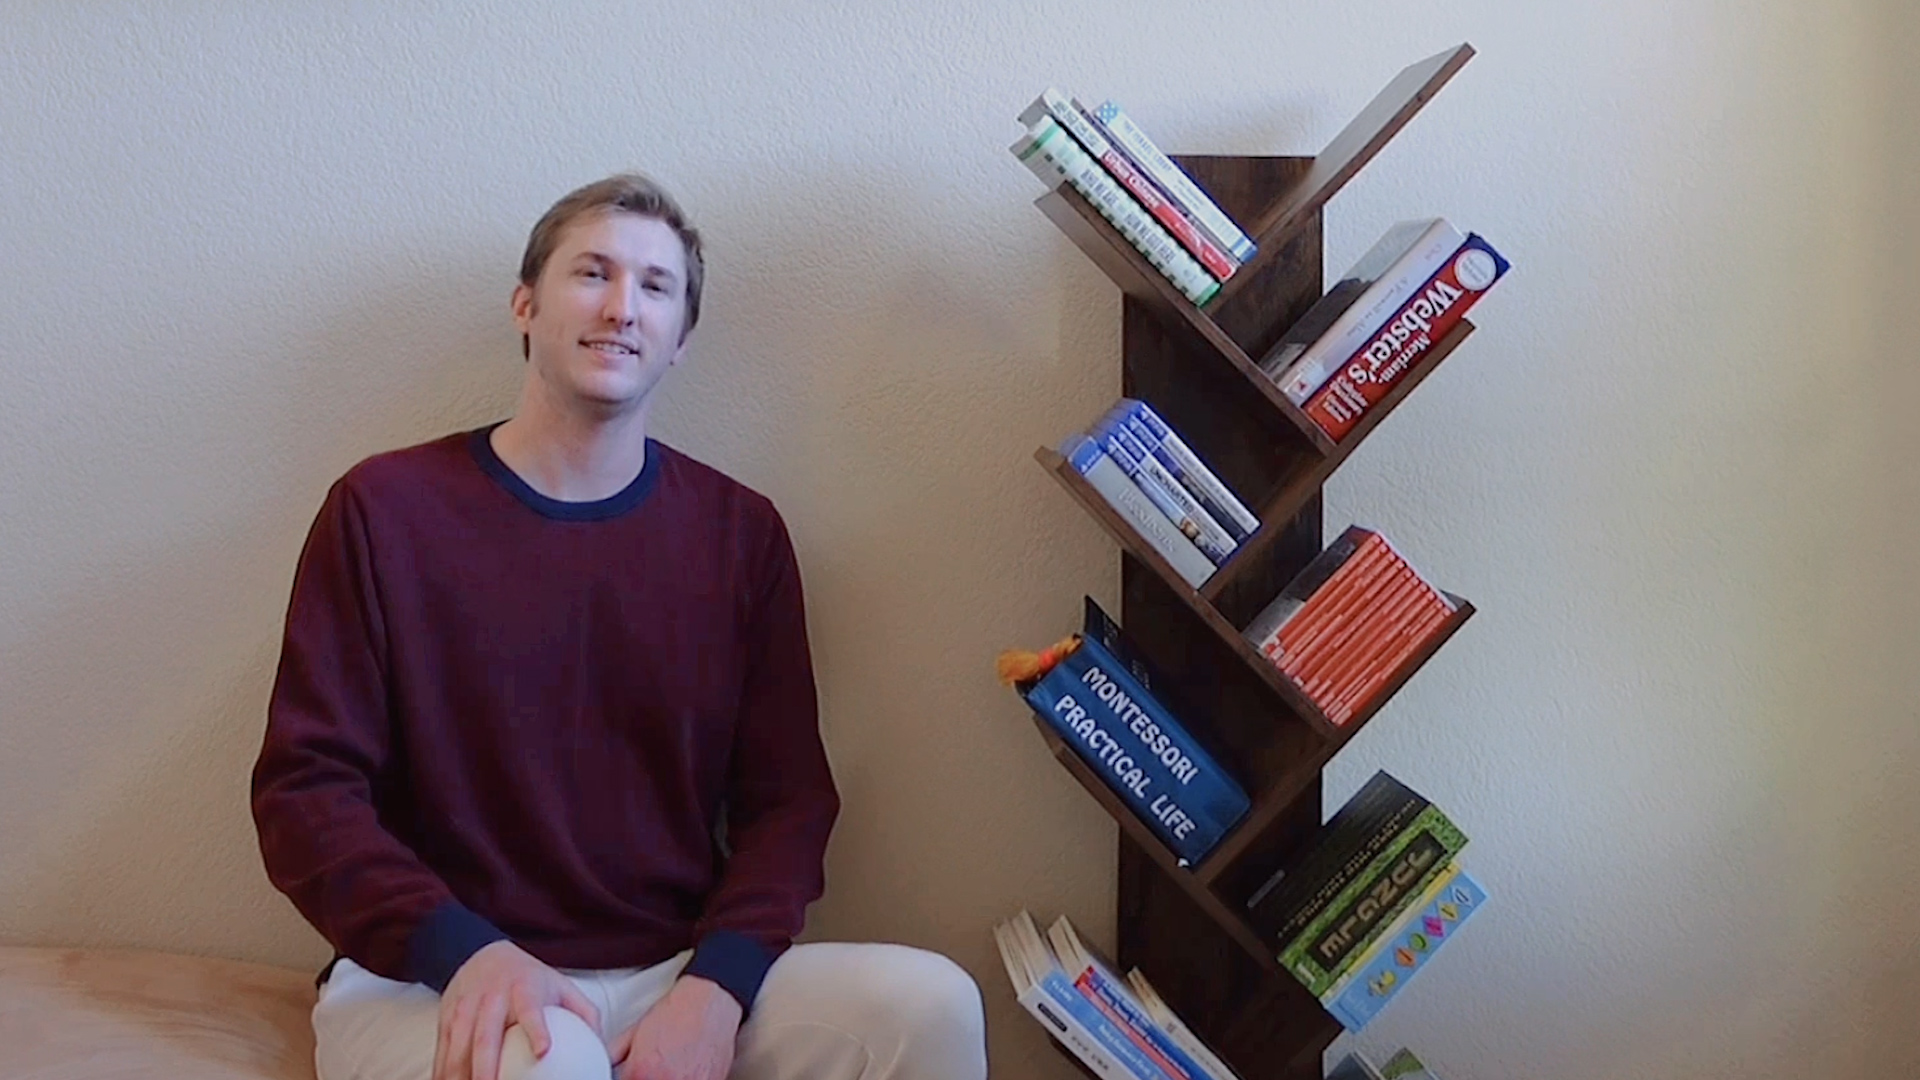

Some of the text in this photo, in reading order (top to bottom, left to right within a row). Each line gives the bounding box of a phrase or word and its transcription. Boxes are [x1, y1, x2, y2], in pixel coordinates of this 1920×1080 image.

[1102, 151, 1131, 179] Urban
[1126, 174, 1161, 209] Chinese
[1347, 279, 1464, 384] Webster's
[1150, 465, 1194, 515] UNCHARTED
[1054, 694, 1196, 841] PRACTICAL LIFE
[1081, 666, 1199, 786] MONTESSORI
[1320, 849, 1432, 958] JUNGLE
